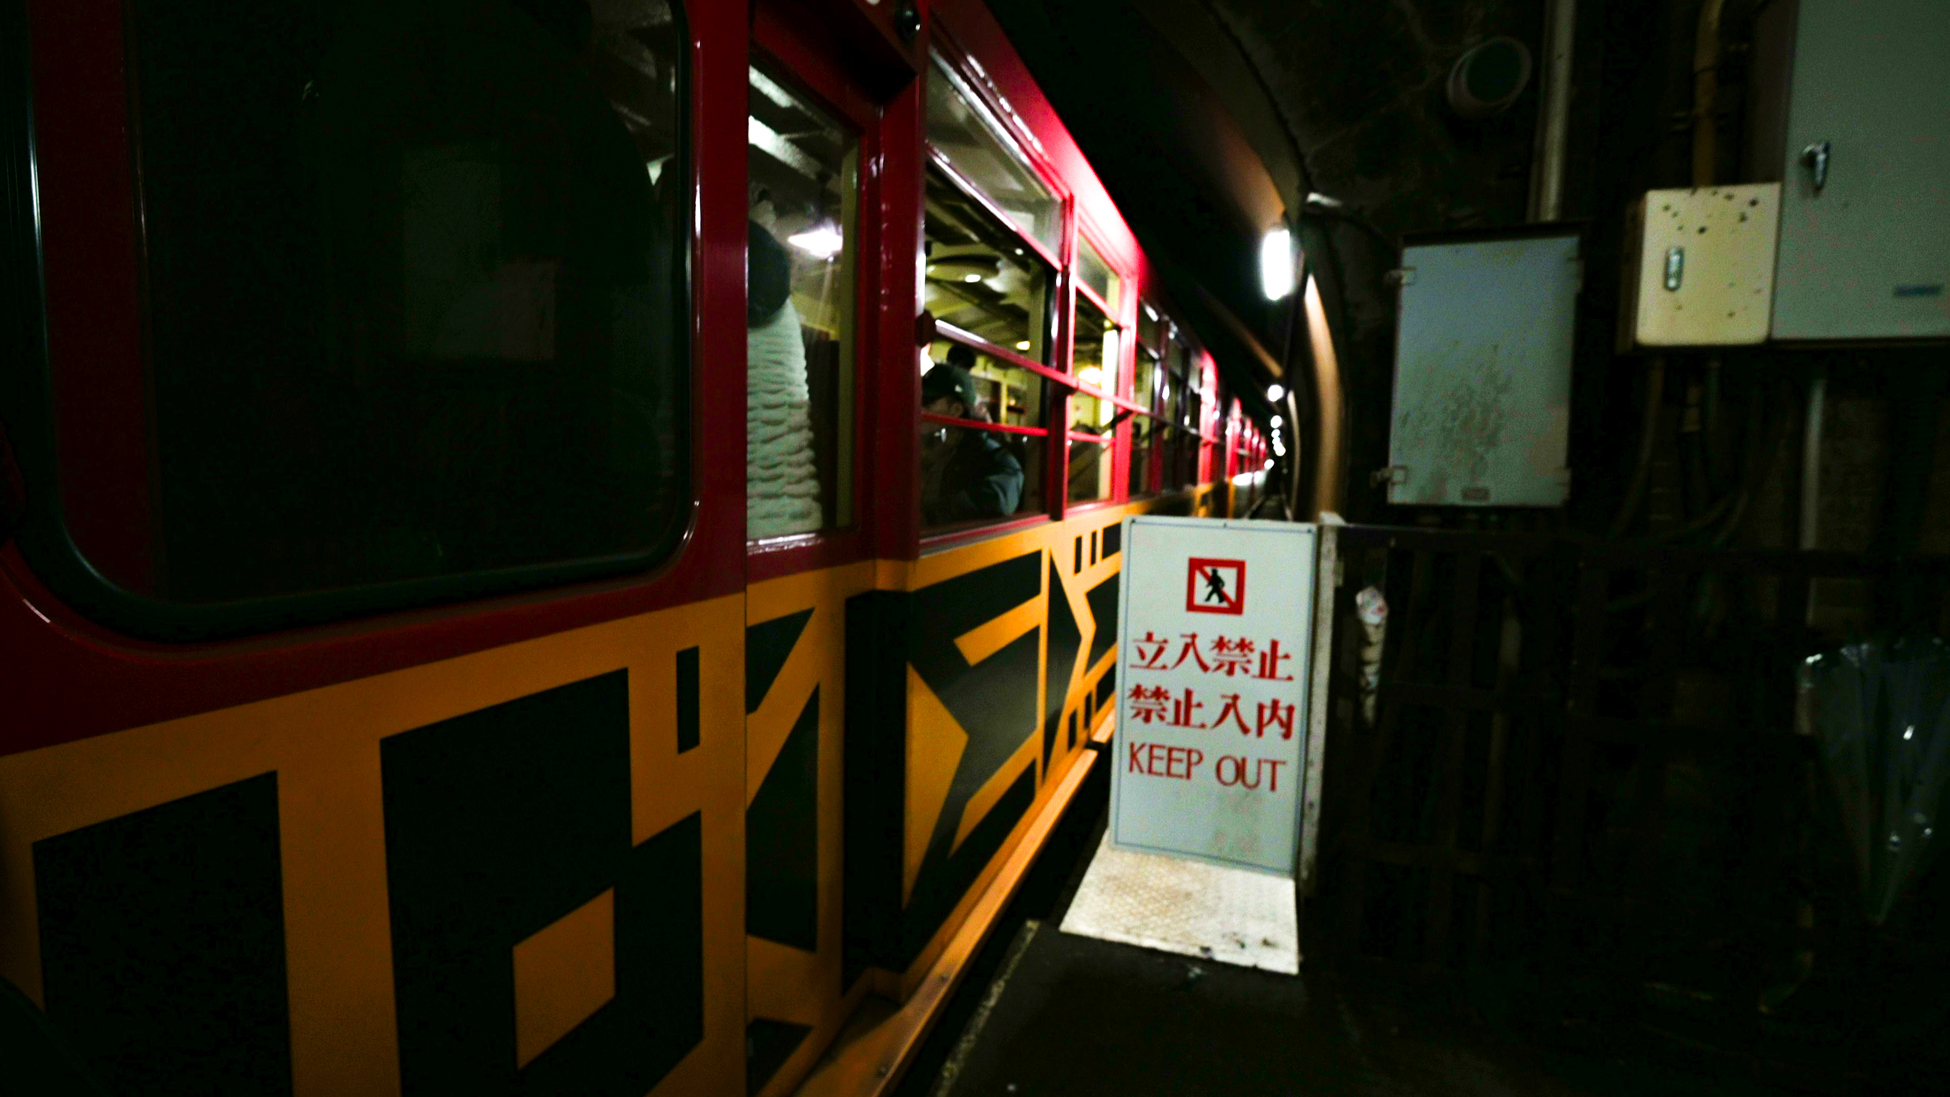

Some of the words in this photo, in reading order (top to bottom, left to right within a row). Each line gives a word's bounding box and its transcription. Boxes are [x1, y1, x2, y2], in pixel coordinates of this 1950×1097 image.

[1130, 631, 1294, 682] 立入禁止
[1127, 684, 1296, 741] 禁止入内
[1128, 742, 1203, 780] KEEP
[1215, 755, 1286, 792] OUT
